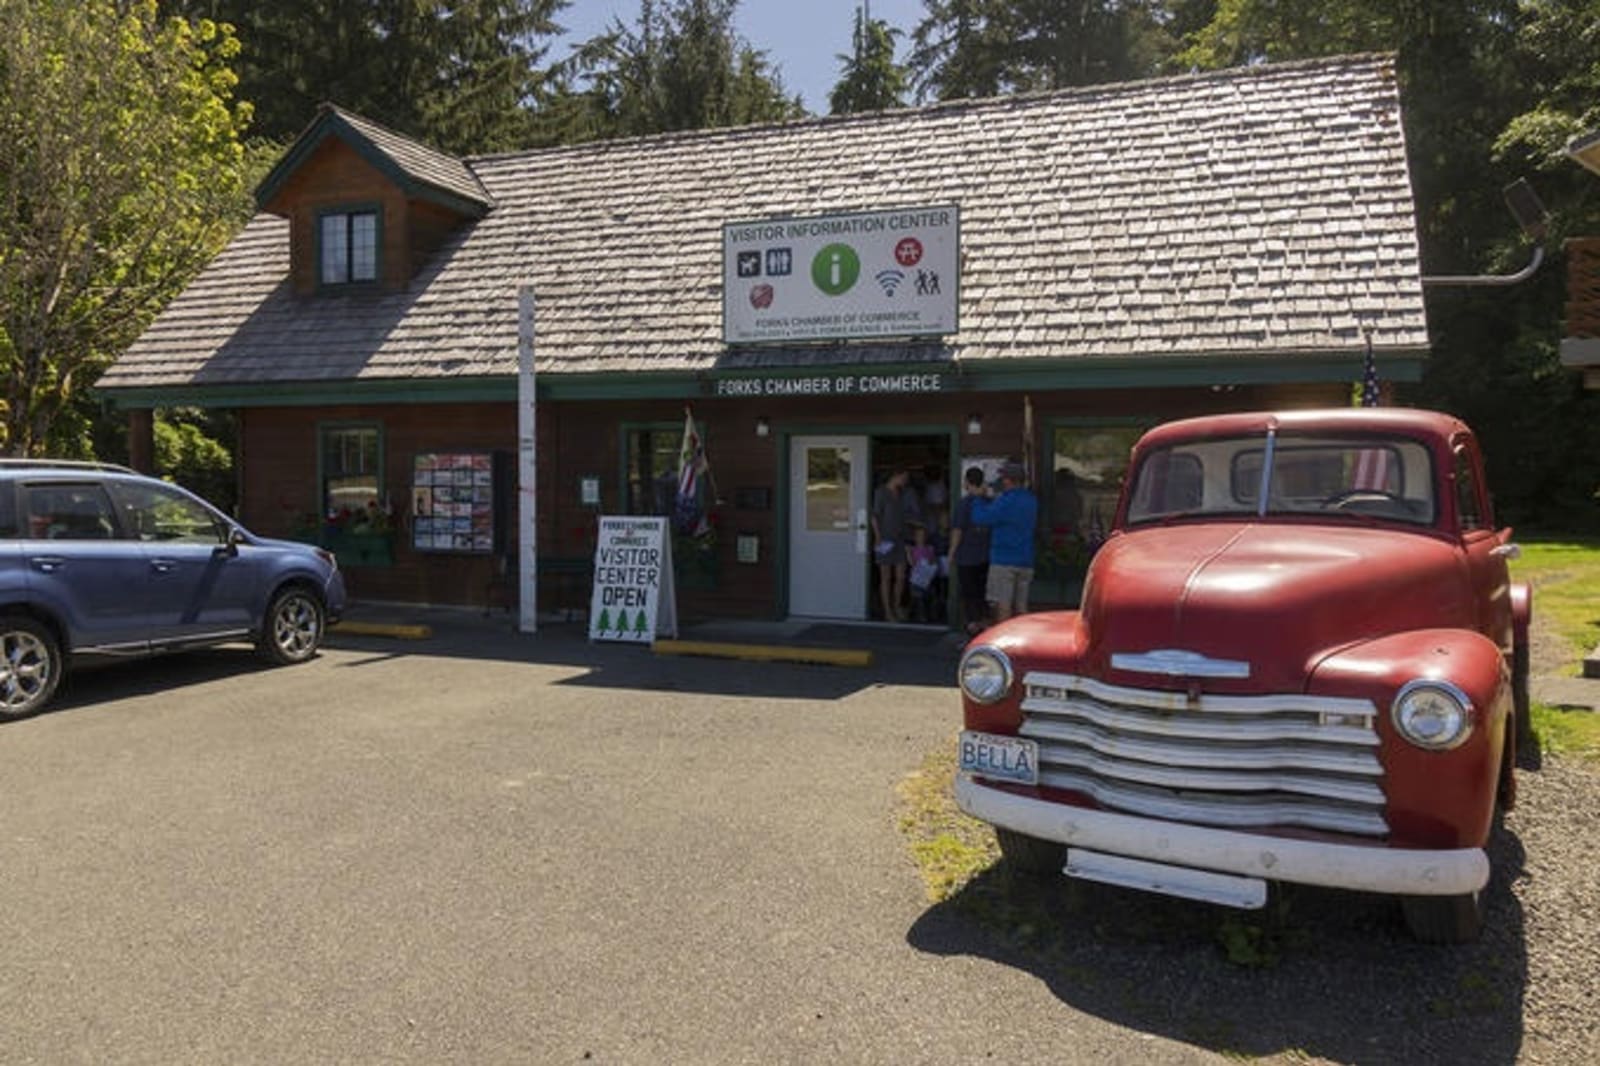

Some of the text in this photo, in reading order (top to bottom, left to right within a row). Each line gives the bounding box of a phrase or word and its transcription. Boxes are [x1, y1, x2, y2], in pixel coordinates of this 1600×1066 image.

[730, 211, 949, 242] VISITOR INFORMATION CENTER
[791, 314, 841, 327] CHAMBER
[843, 313, 856, 323] OF
[859, 311, 920, 322] COMMERCE
[718, 374, 941, 395] FORKS CHAMBER OF COMMERCE
[600, 547, 660, 568] VISITOR
[597, 566, 658, 588] CENTER
[602, 585, 647, 608] OPEN
[963, 741, 1033, 773] BELLA
